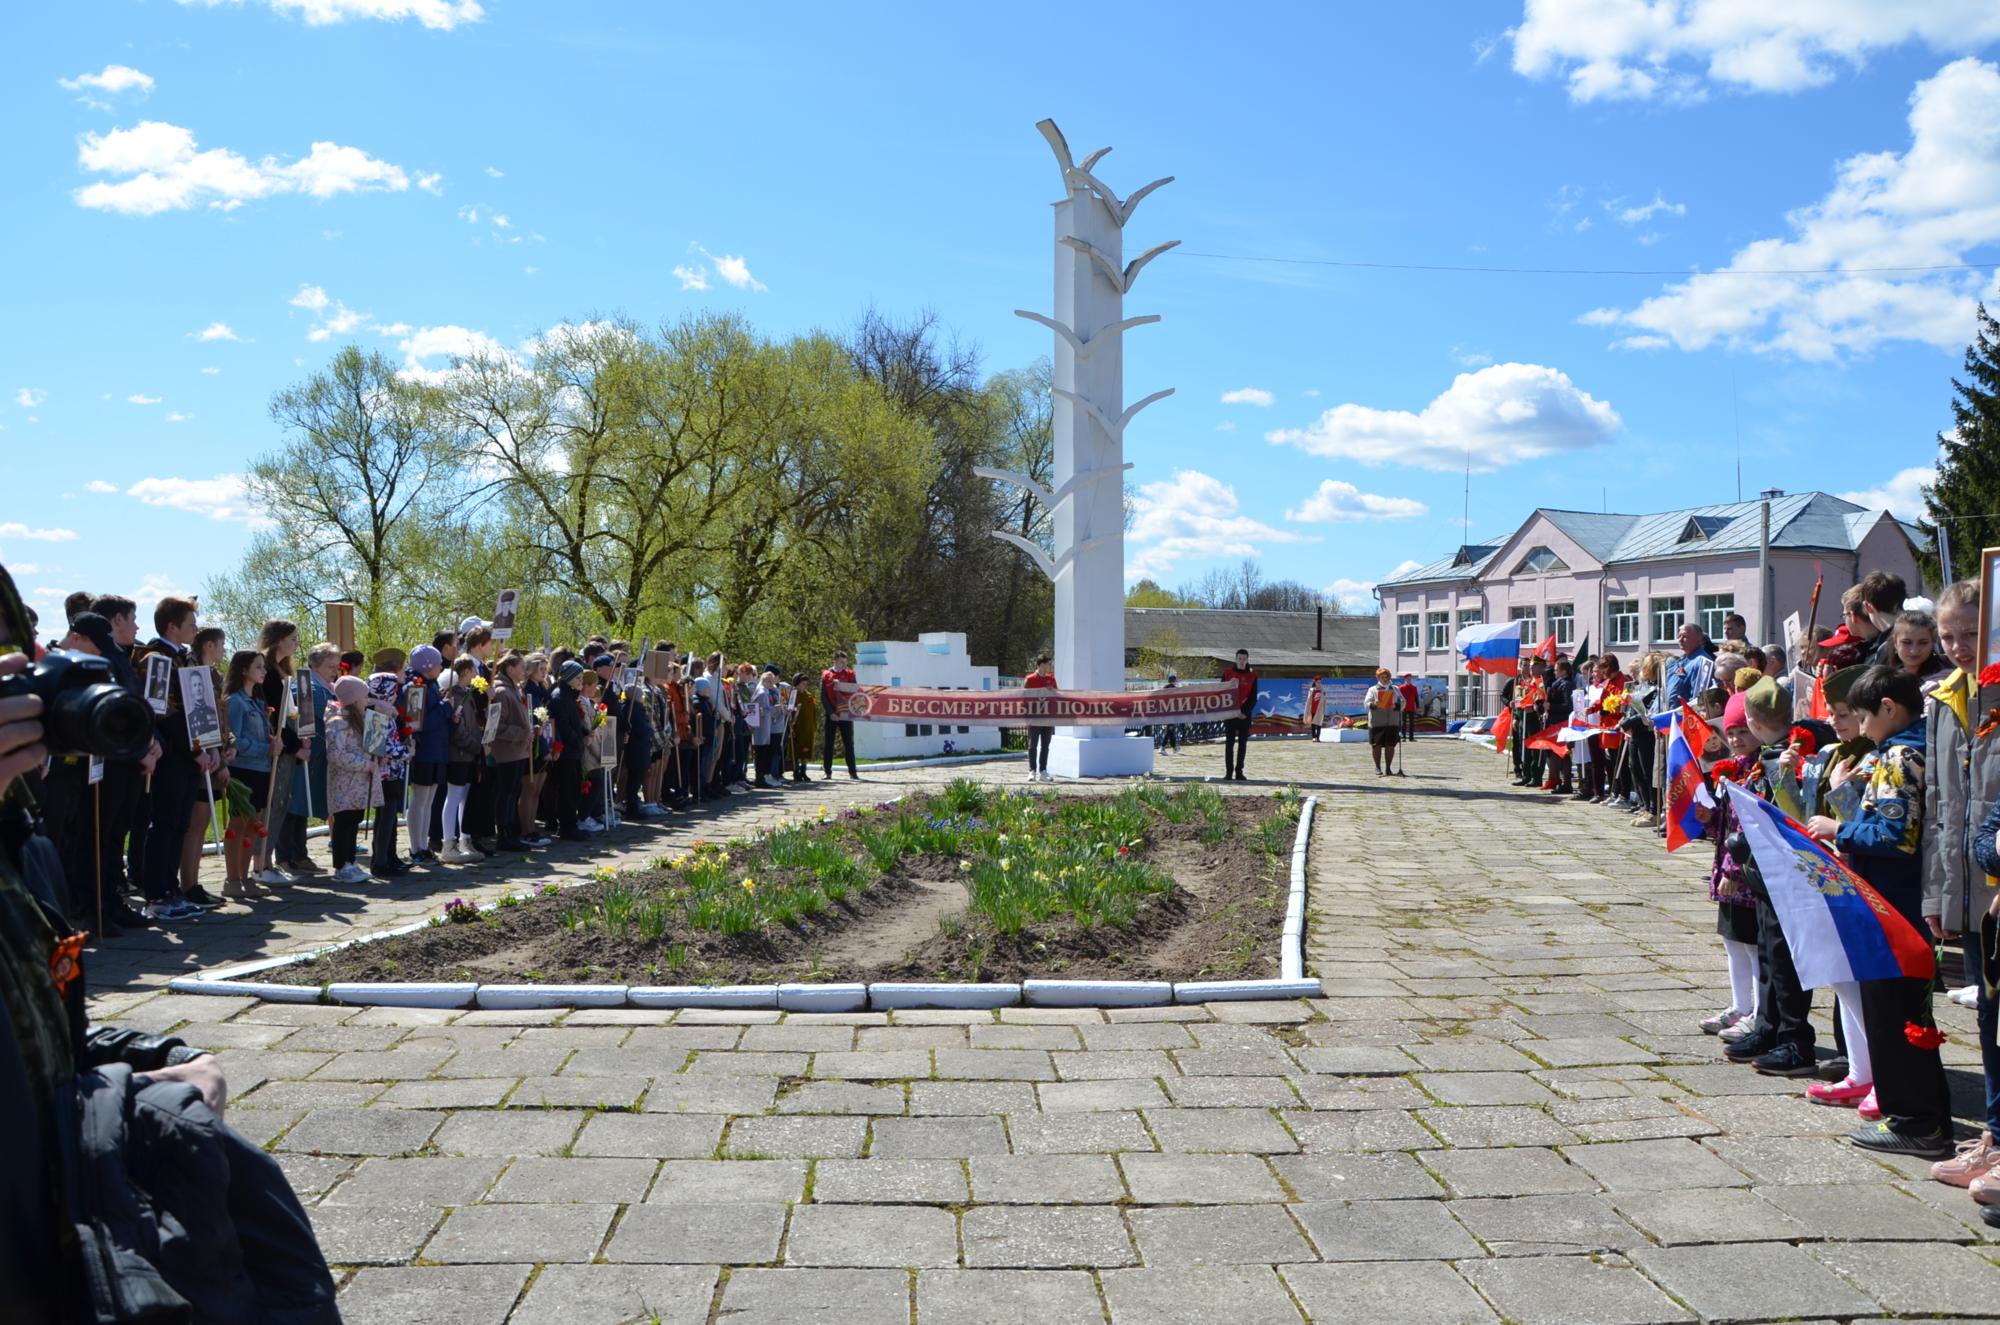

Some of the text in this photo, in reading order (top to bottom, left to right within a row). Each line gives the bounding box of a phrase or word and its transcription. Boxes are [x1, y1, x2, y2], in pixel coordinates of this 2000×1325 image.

[887, 697, 1049, 716] БЕССМЕРТНЫЙ
[1056, 701, 1115, 715] ПОЛК
[1131, 693, 1233, 718] ДЕМИДОВ
